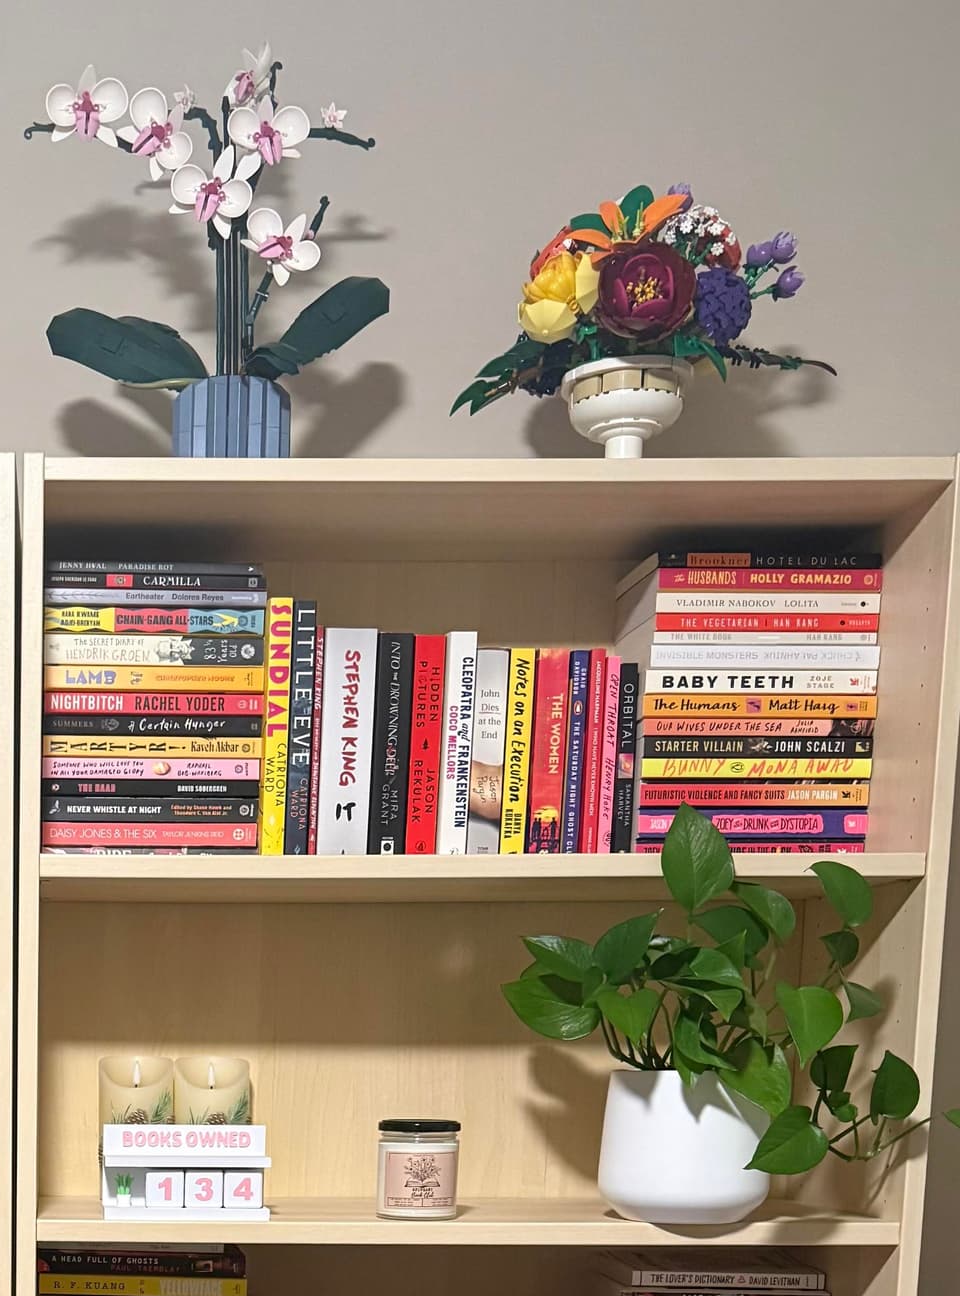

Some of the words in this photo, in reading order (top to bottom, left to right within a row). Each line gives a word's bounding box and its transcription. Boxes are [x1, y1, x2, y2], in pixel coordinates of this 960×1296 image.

[143, 576, 201, 586] CARMILLA
[750, 574, 785, 584] HOLLY
[790, 574, 852, 585] GRAMAZIO
[267, 604, 291, 737] SUNDIAL
[296, 609, 315, 704] LITTLE
[51, 695, 123, 710] NIGHTBITCH
[135, 697, 181, 711] RACHEL
[186, 697, 225, 711] YODER
[342, 650, 362, 729] STEPHEN
[461, 657, 474, 721] CLEOPATRA
[662, 676, 718, 688] BABY
[728, 676, 794, 688] TEETH
[462, 724, 471, 742] and
[623, 683, 634, 748] ORBITAL
[292, 716, 311, 766] EVE
[339, 736, 359, 787] KING
[655, 741, 699, 752] STARTER
[703, 741, 743, 752] VILLAIN
[774, 741, 803, 752] JOHN
[806, 741, 845, 753] SCALZI
[454, 745, 470, 828] FRANKENSTEIN
[122, 1131, 182, 1148] BOOKS
[186, 1131, 251, 1148] OWNED
